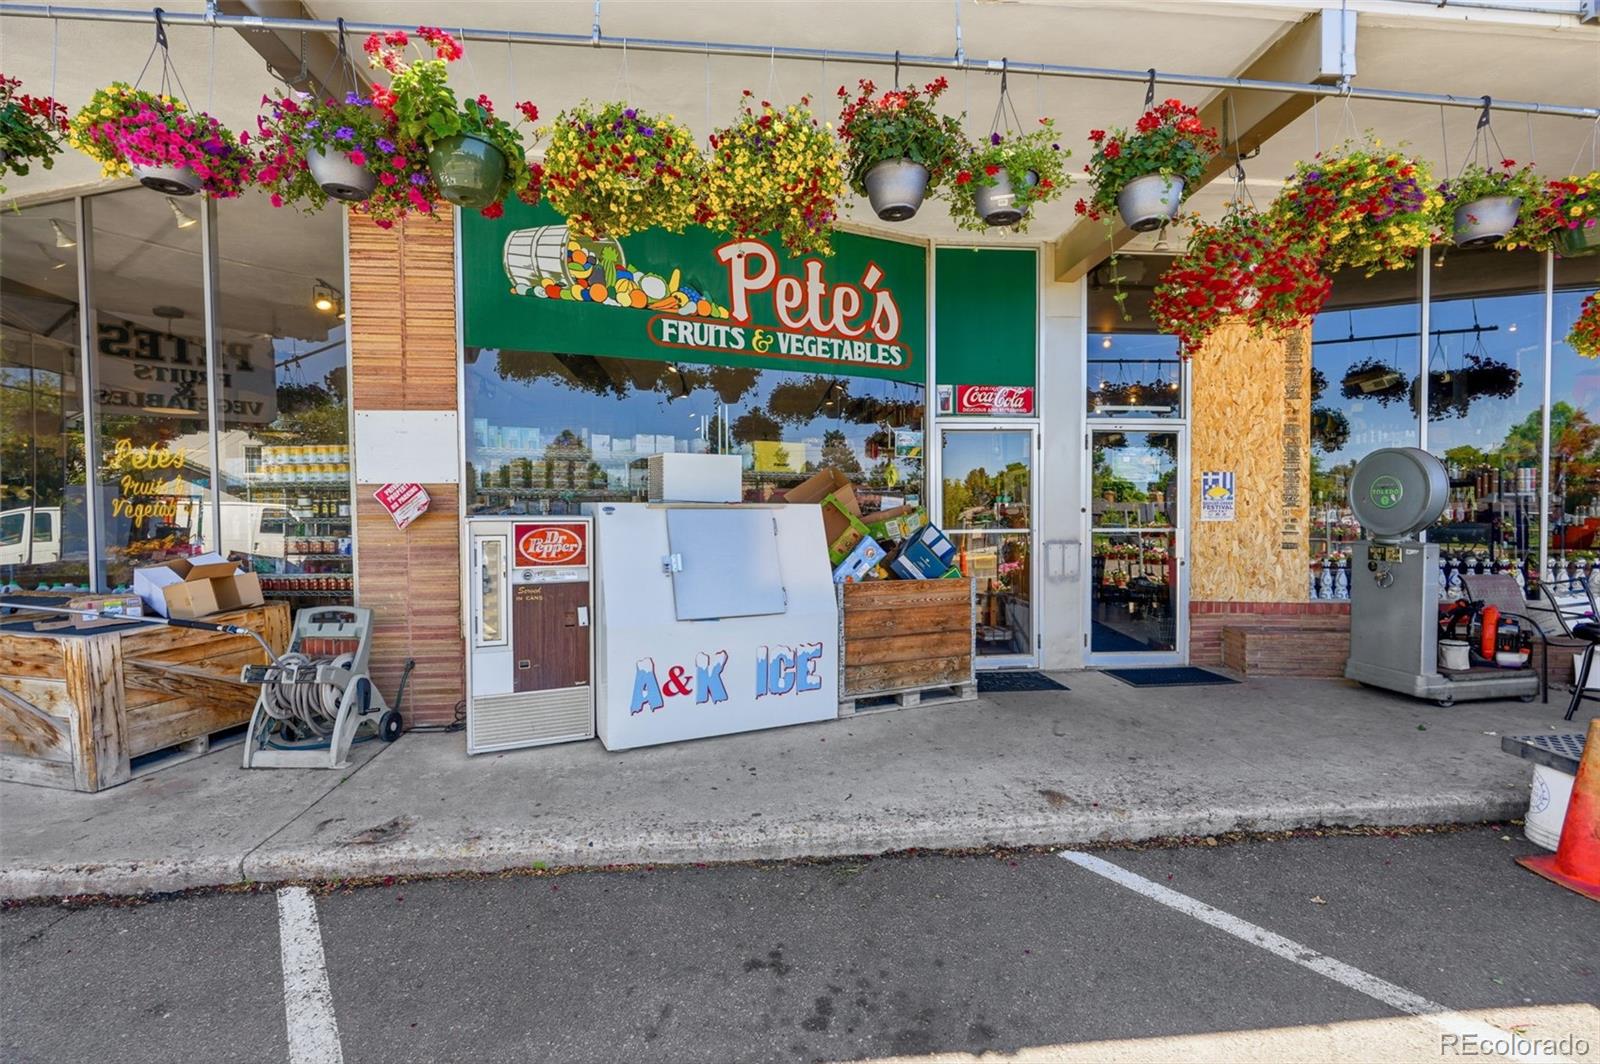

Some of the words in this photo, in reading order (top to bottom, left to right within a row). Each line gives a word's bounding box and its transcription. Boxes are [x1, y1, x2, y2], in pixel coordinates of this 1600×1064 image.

[715, 239, 900, 342] Pete's
[661, 318, 746, 350] FRUITS
[751, 329, 774, 353] &
[776, 331, 903, 366] VEGETABLES
[111, 498, 193, 528] Vegetabs
[527, 537, 578, 558] Pepper
[545, 530, 567, 544] Dr
[630, 650, 729, 716] A&K
[755, 641, 823, 700] ICE
